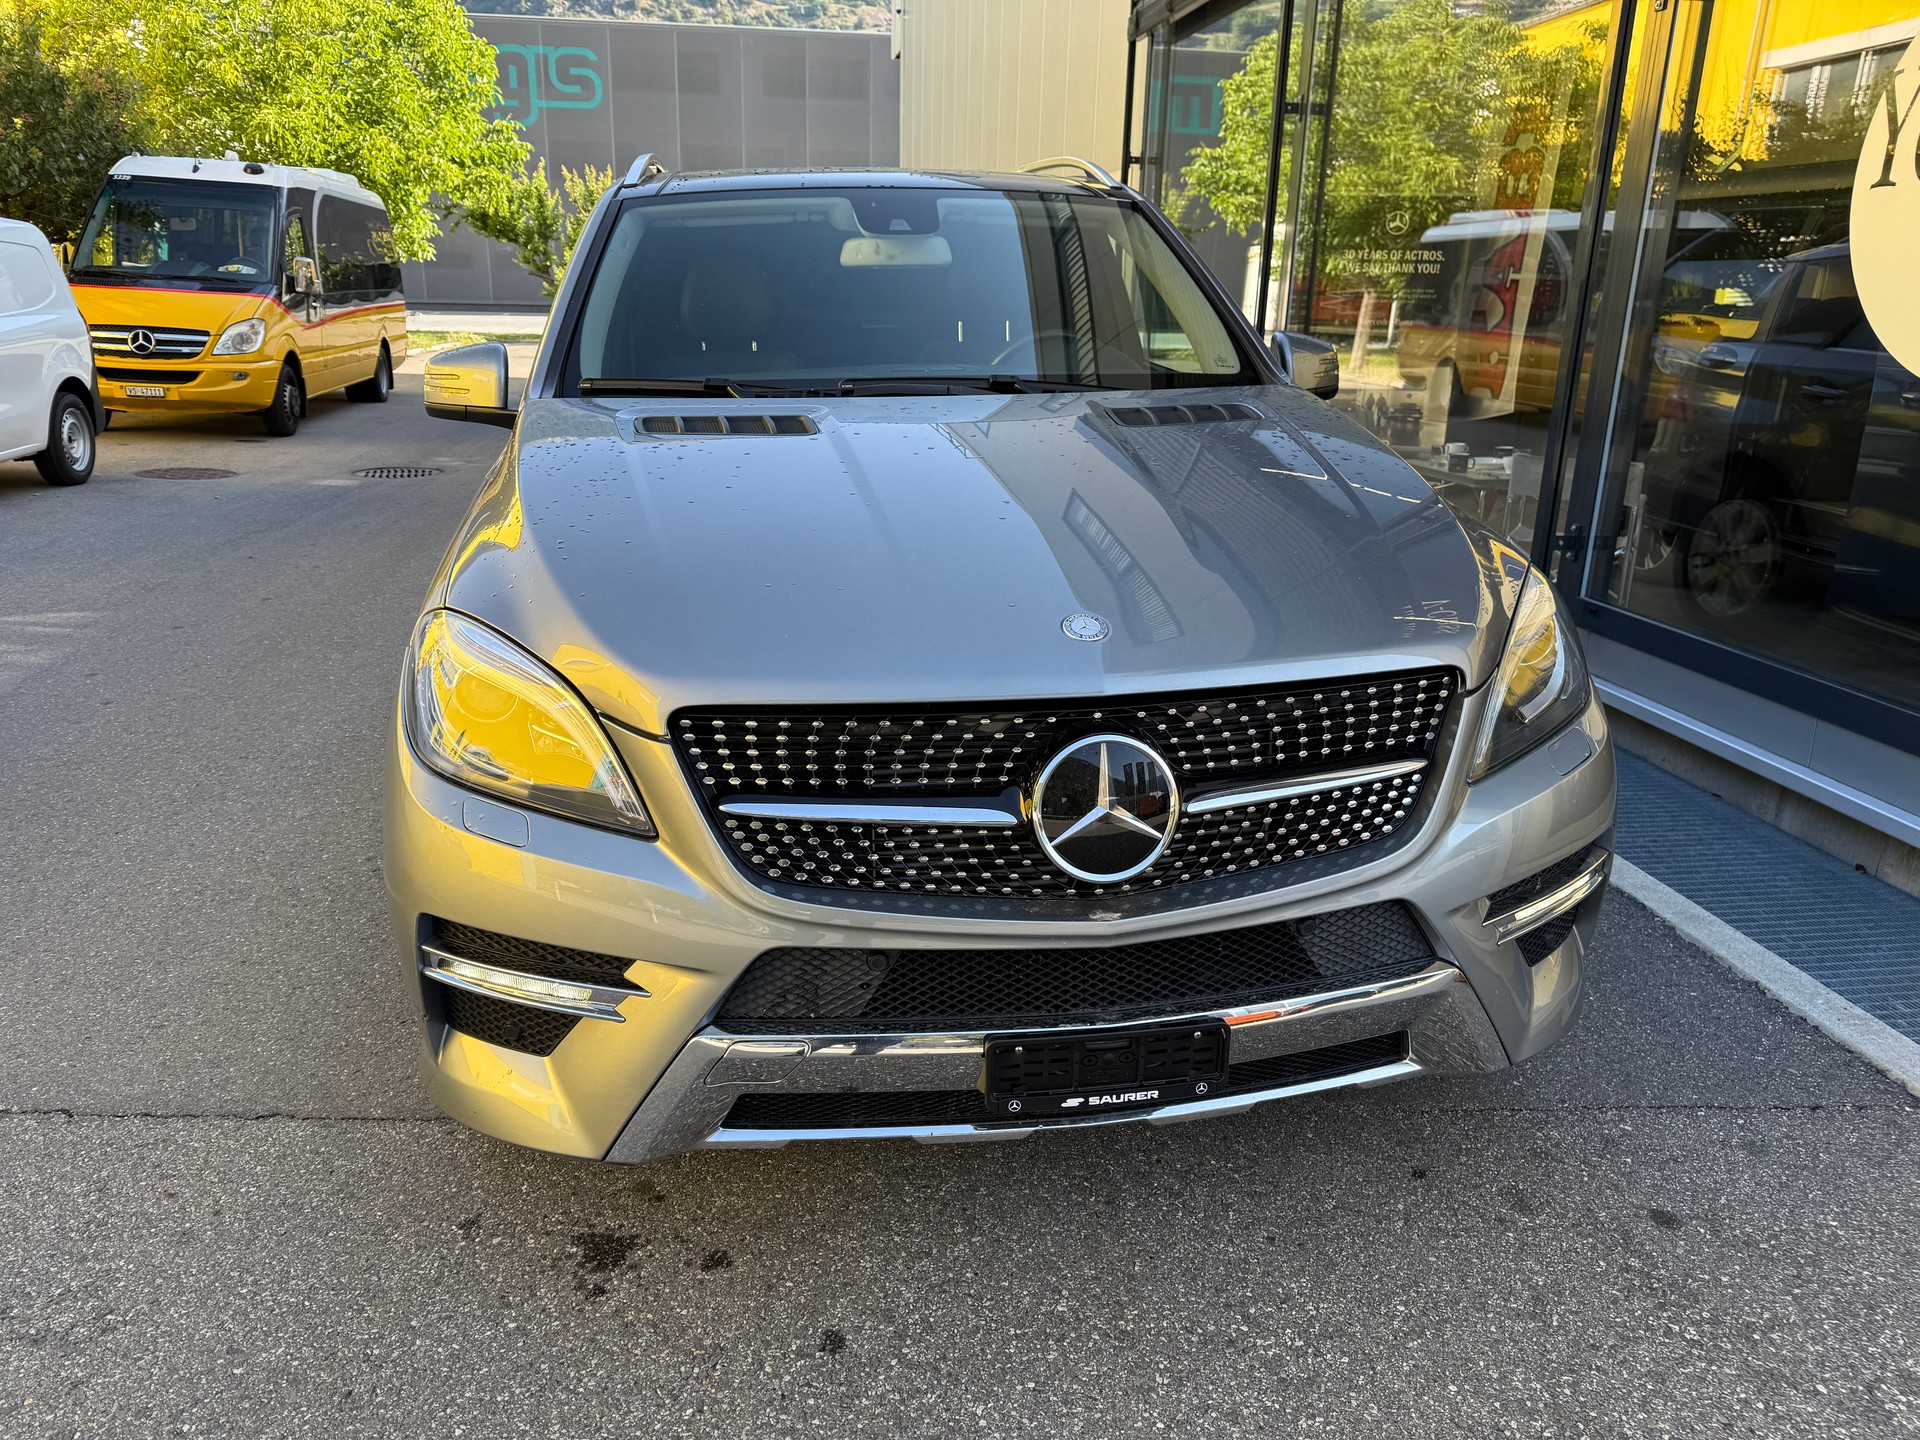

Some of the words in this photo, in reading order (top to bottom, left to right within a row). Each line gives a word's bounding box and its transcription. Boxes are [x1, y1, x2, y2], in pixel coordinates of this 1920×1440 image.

[1869, 65, 1920, 190] Y
[1343, 249, 1355, 260] 30
[1357, 249, 1388, 260] YEARS
[1390, 249, 1403, 260] OF
[1404, 250, 1445, 261] ACTROS.
[1345, 262, 1361, 272] WE
[1363, 262, 1381, 273] SAY
[1383, 262, 1415, 273] THANK
[1417, 263, 1440, 274] YOU!
[1088, 1090, 1159, 1106] SAURER
